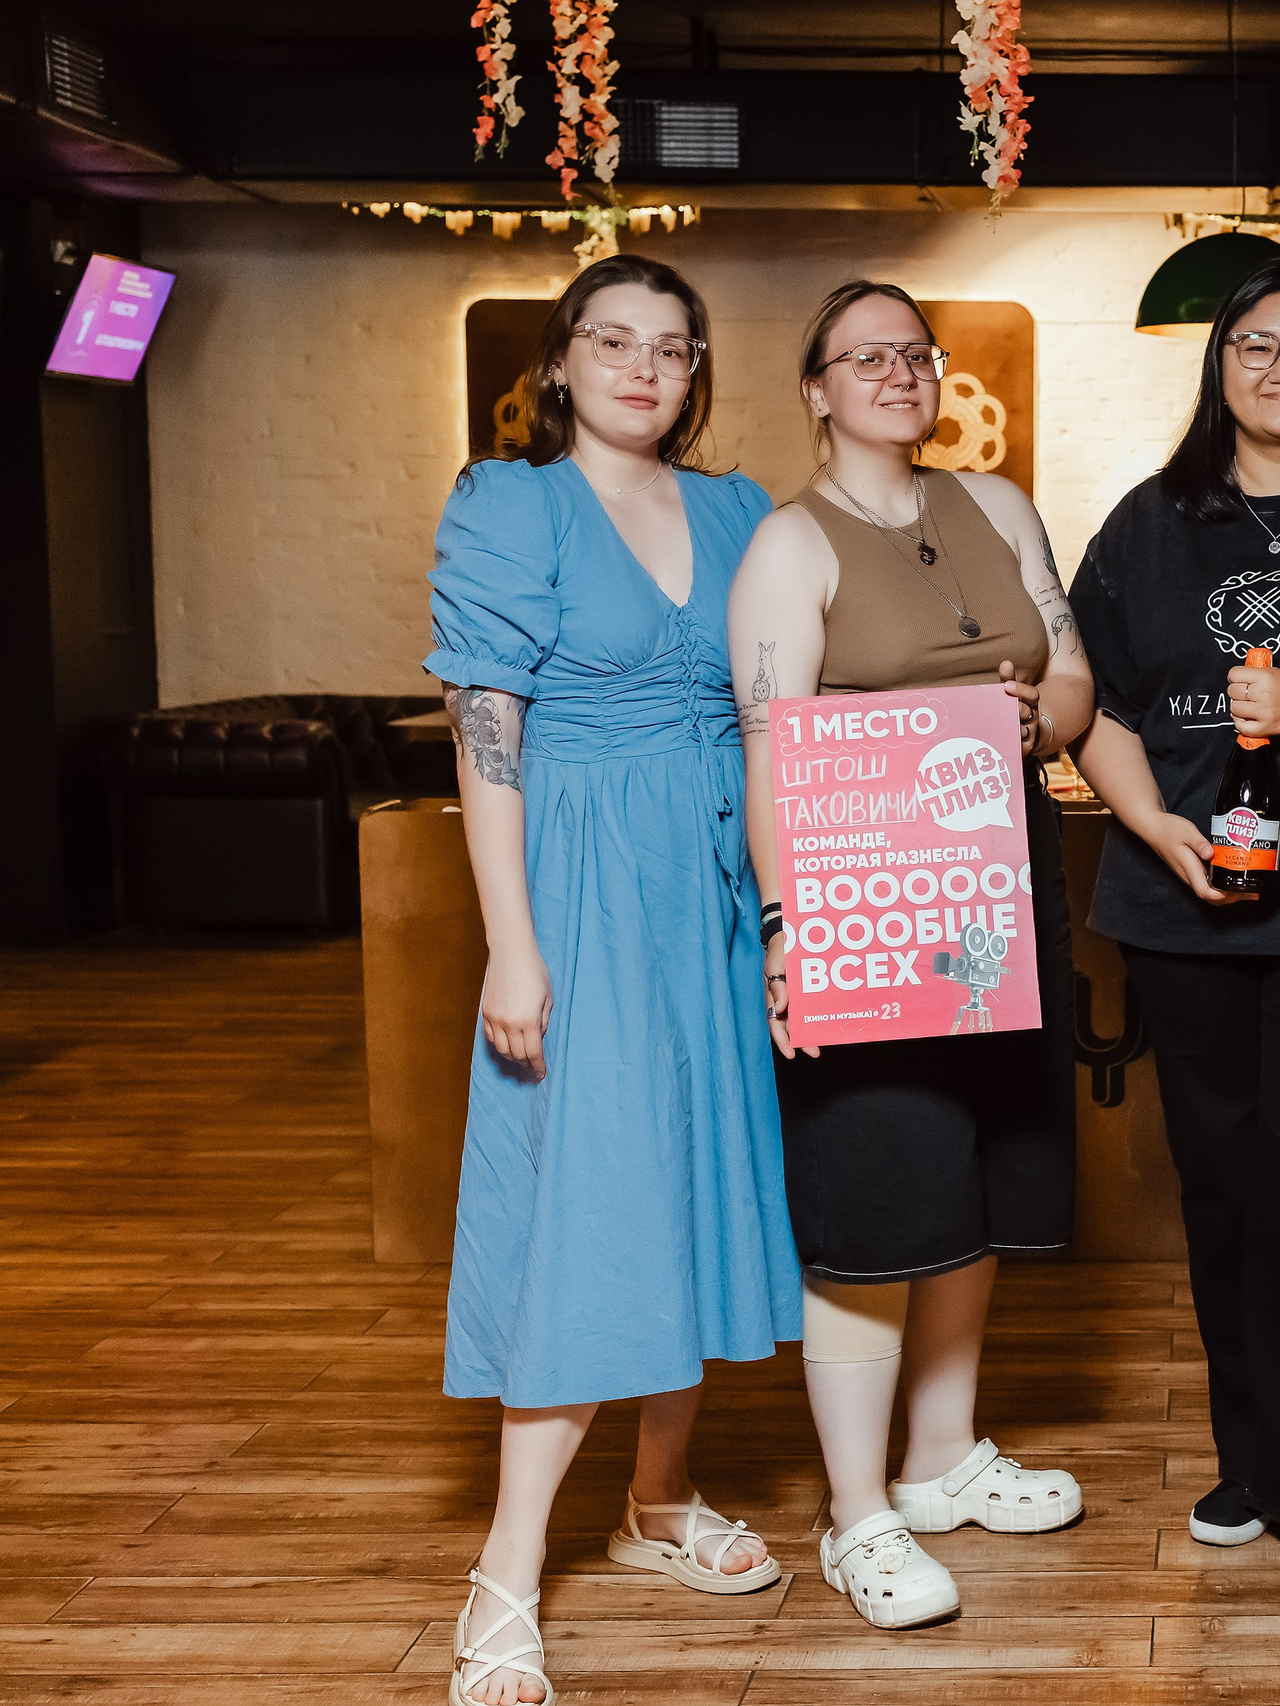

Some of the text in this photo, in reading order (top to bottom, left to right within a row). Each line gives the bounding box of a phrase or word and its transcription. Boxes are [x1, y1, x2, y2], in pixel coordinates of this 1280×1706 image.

[1168, 692, 1233, 716] KAZA
[787, 707, 938, 743] 1 МЕСТО
[781, 754, 887, 788] ШТОШ
[917, 747, 1006, 795] КВИЗ,
[775, 789, 918, 829] ТАКОВИЧИ
[921, 771, 1012, 820] ПЛИЗ!
[792, 831, 892, 853] КОМАНДЕ,
[1226, 824, 1257, 838] ПЛИЗ!
[794, 845, 983, 873] КОТОРАЯ РАЗНЕСЛА
[800, 950, 923, 994] ВСЕХ
[829, 1013, 836, 1021] И
[880, 1001, 901, 1020] 23
